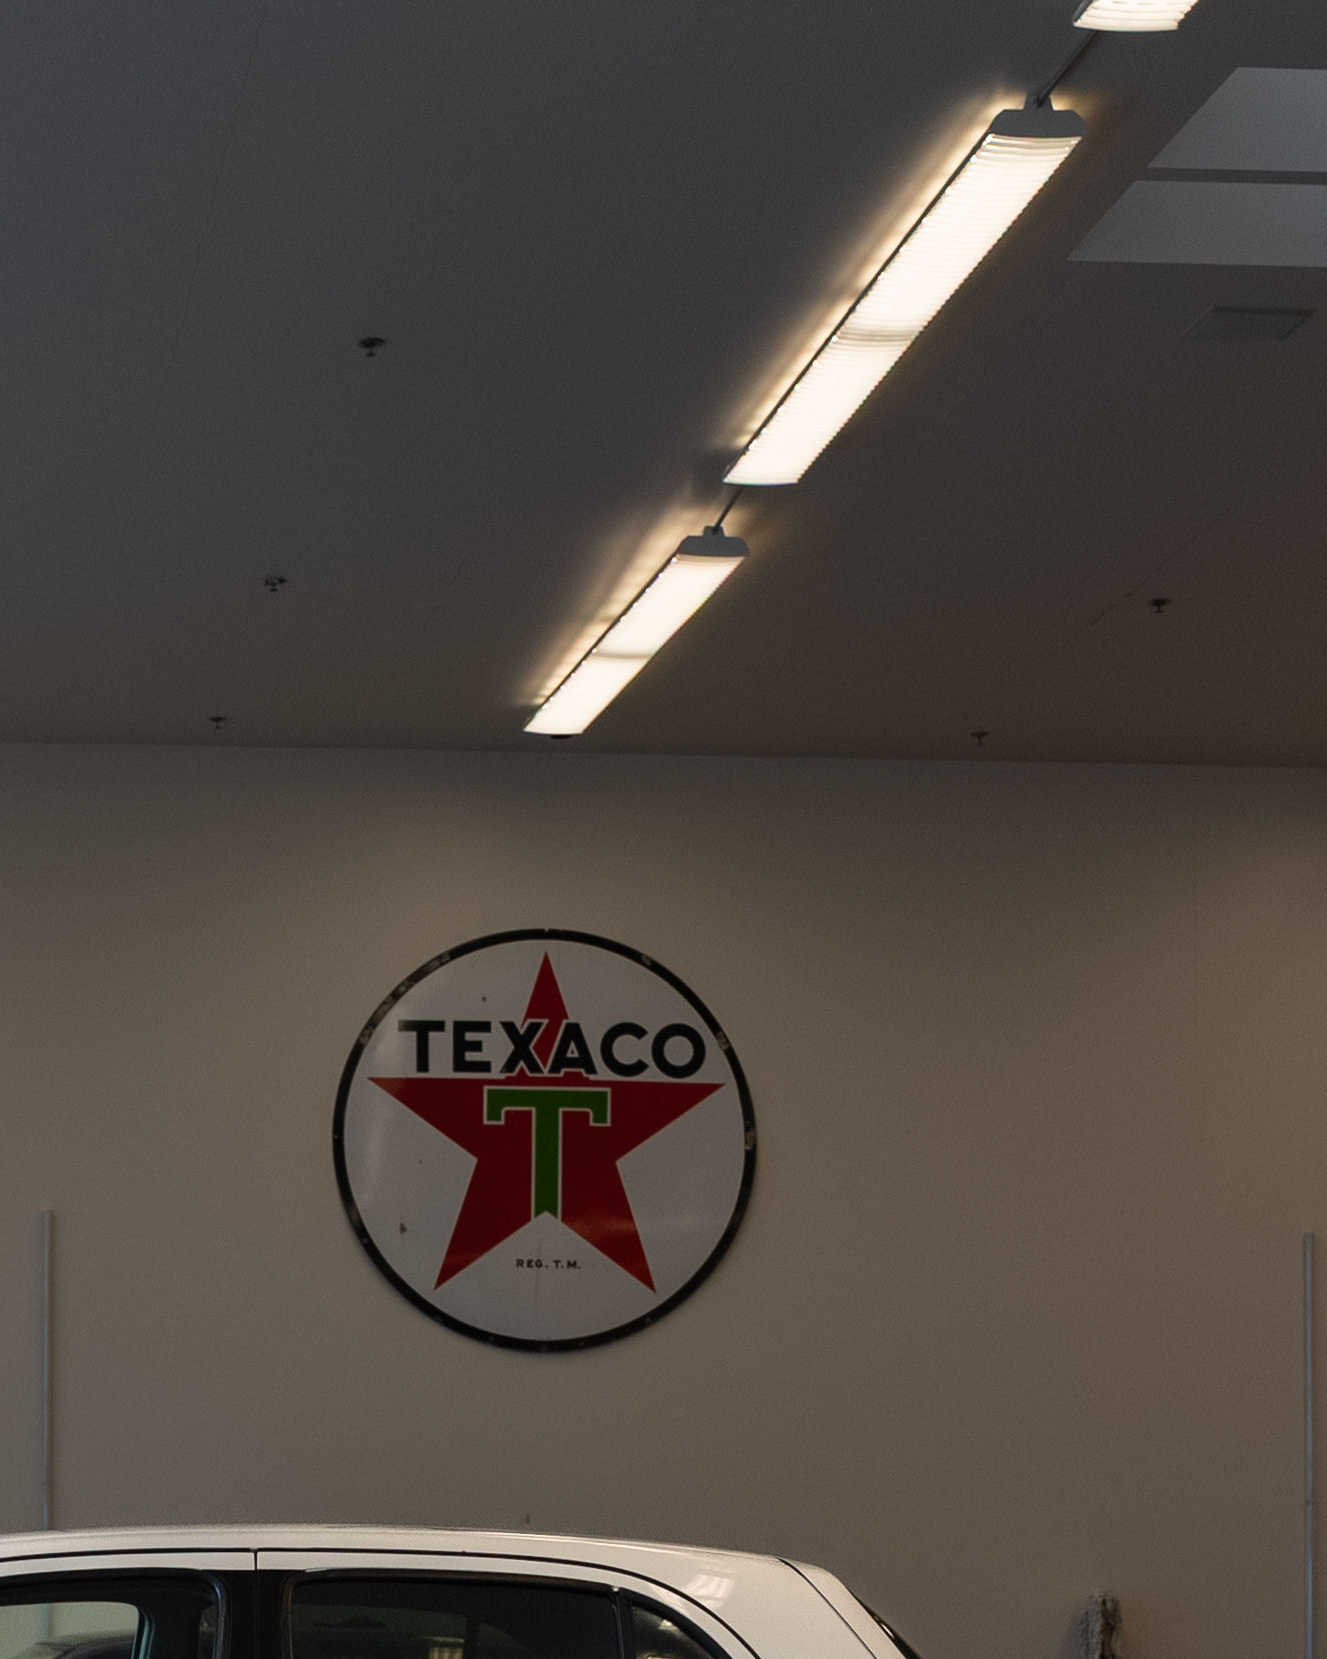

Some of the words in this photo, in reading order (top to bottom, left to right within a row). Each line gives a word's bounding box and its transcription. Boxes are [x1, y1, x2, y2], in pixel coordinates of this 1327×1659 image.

[397, 1019, 706, 1079] TEXACO
[483, 1086, 611, 1221] T
[516, 1259, 548, 1270] REG.
[553, 1259, 582, 1270] T.M.
